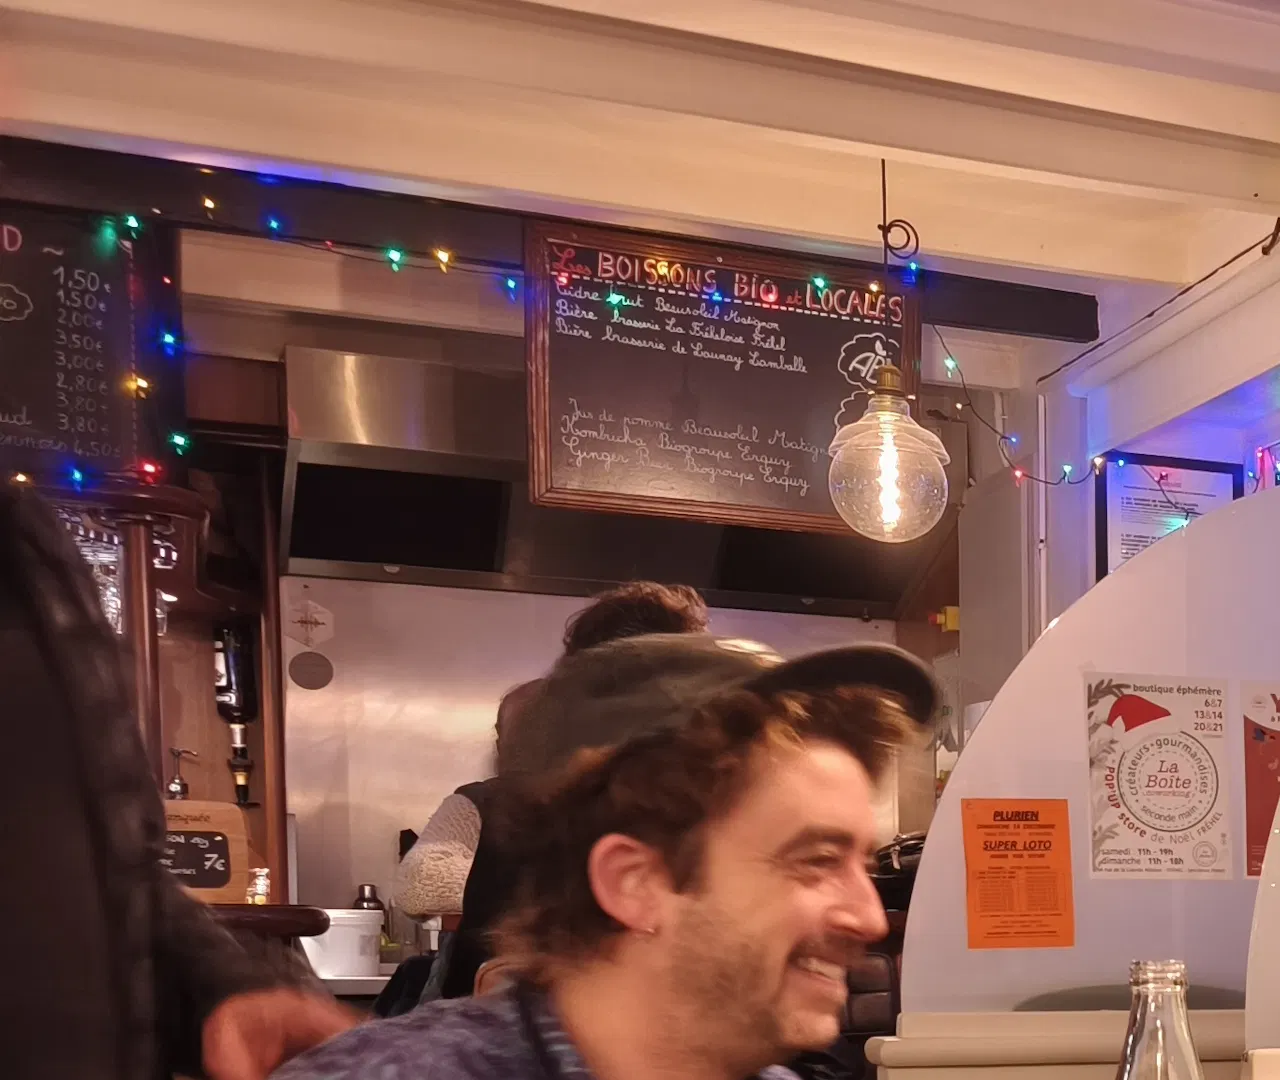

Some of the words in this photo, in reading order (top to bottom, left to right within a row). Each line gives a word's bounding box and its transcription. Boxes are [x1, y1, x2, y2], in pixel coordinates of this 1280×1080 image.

[597, 251, 717, 293] BOISSONS
[785, 291, 803, 304] et
[806, 283, 903, 322] LOCALES
[555, 298, 598, 320] Bière
[610, 306, 661, 331] brasserie
[665, 316, 686, 333] La
[724, 309, 780, 333] Matignon
[555, 317, 592, 339] Bière
[601, 325, 667, 351] brasserie
[672, 341, 687, 354] de
[691, 342, 744, 371] Launay
[749, 351, 808, 373] Lamballe
[598, 408, 615, 422] de
[682, 419, 760, 443] Beausoleil
[657, 432, 732, 461] Biogroupe
[738, 443, 793, 474] Erquy
[562, 436, 629, 472] Ginger
[684, 455, 755, 486] Biogroupe
[759, 465, 811, 497] Erquy
[1133, 684, 1175, 698] boutique
[1177, 685, 1222, 696] éphémère
[1194, 710, 1223, 719] 13&14
[1194, 722, 1223, 732] 20&21
[1125, 743, 1150, 796] créateurs
[1155, 736, 1209, 795] gourmandises
[1157, 760, 1180, 774] La
[1145, 774, 1192, 789] Boîte
[993, 810, 1040, 822] PLURIEN
[1140, 804, 1177, 822] seconde
[1177, 804, 1198, 821] main
[1117, 812, 1148, 838] store
[1150, 833, 1166, 844] de
[1169, 831, 1195, 845] Noël
[1197, 811, 1224, 837] FRÉHEL
[983, 840, 1018, 851] SUPER
[1023, 840, 1052, 851] LOTO
[1101, 847, 1131, 856] samedi
[204, 853, 226, 871] 7€
[1099, 856, 1142, 866] dimanche
